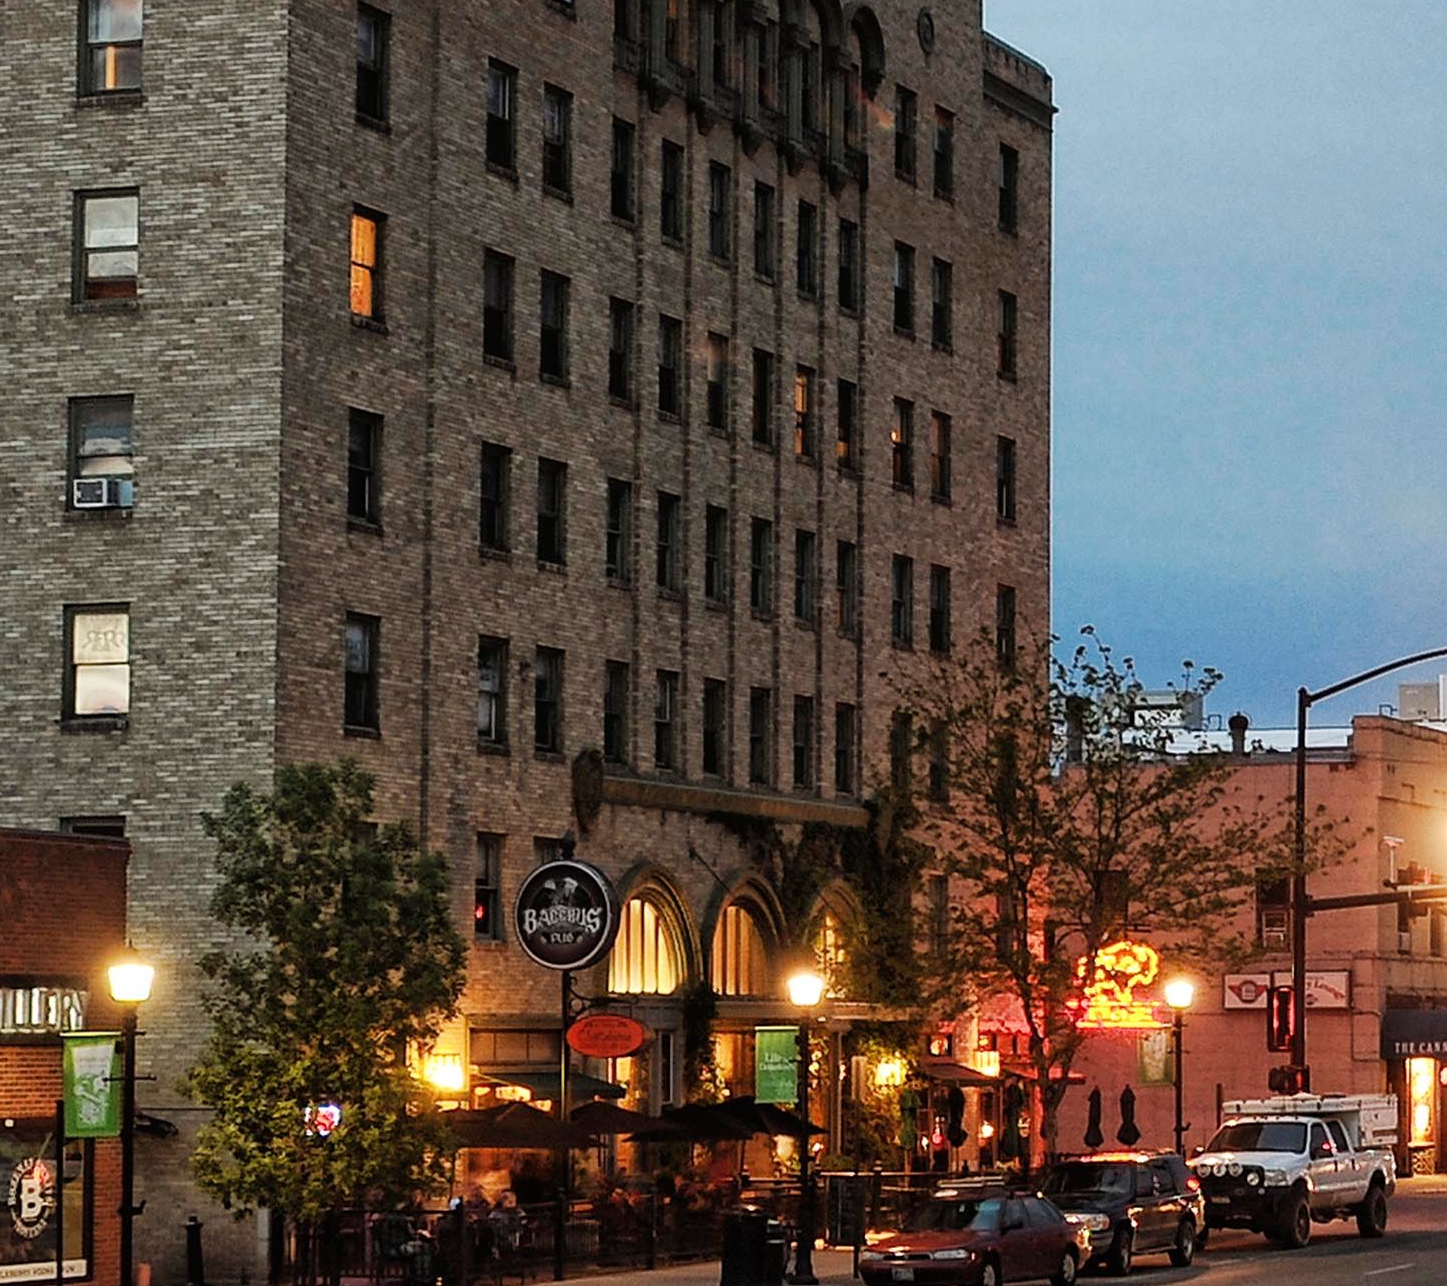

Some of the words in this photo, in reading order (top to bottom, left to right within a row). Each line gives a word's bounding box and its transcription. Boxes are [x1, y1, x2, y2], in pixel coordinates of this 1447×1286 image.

[523, 907, 603, 935] BACCHUS
[550, 932, 575, 945] PUB
[1394, 1041, 1415, 1054] THE
[20, 1178, 44, 1218] B
